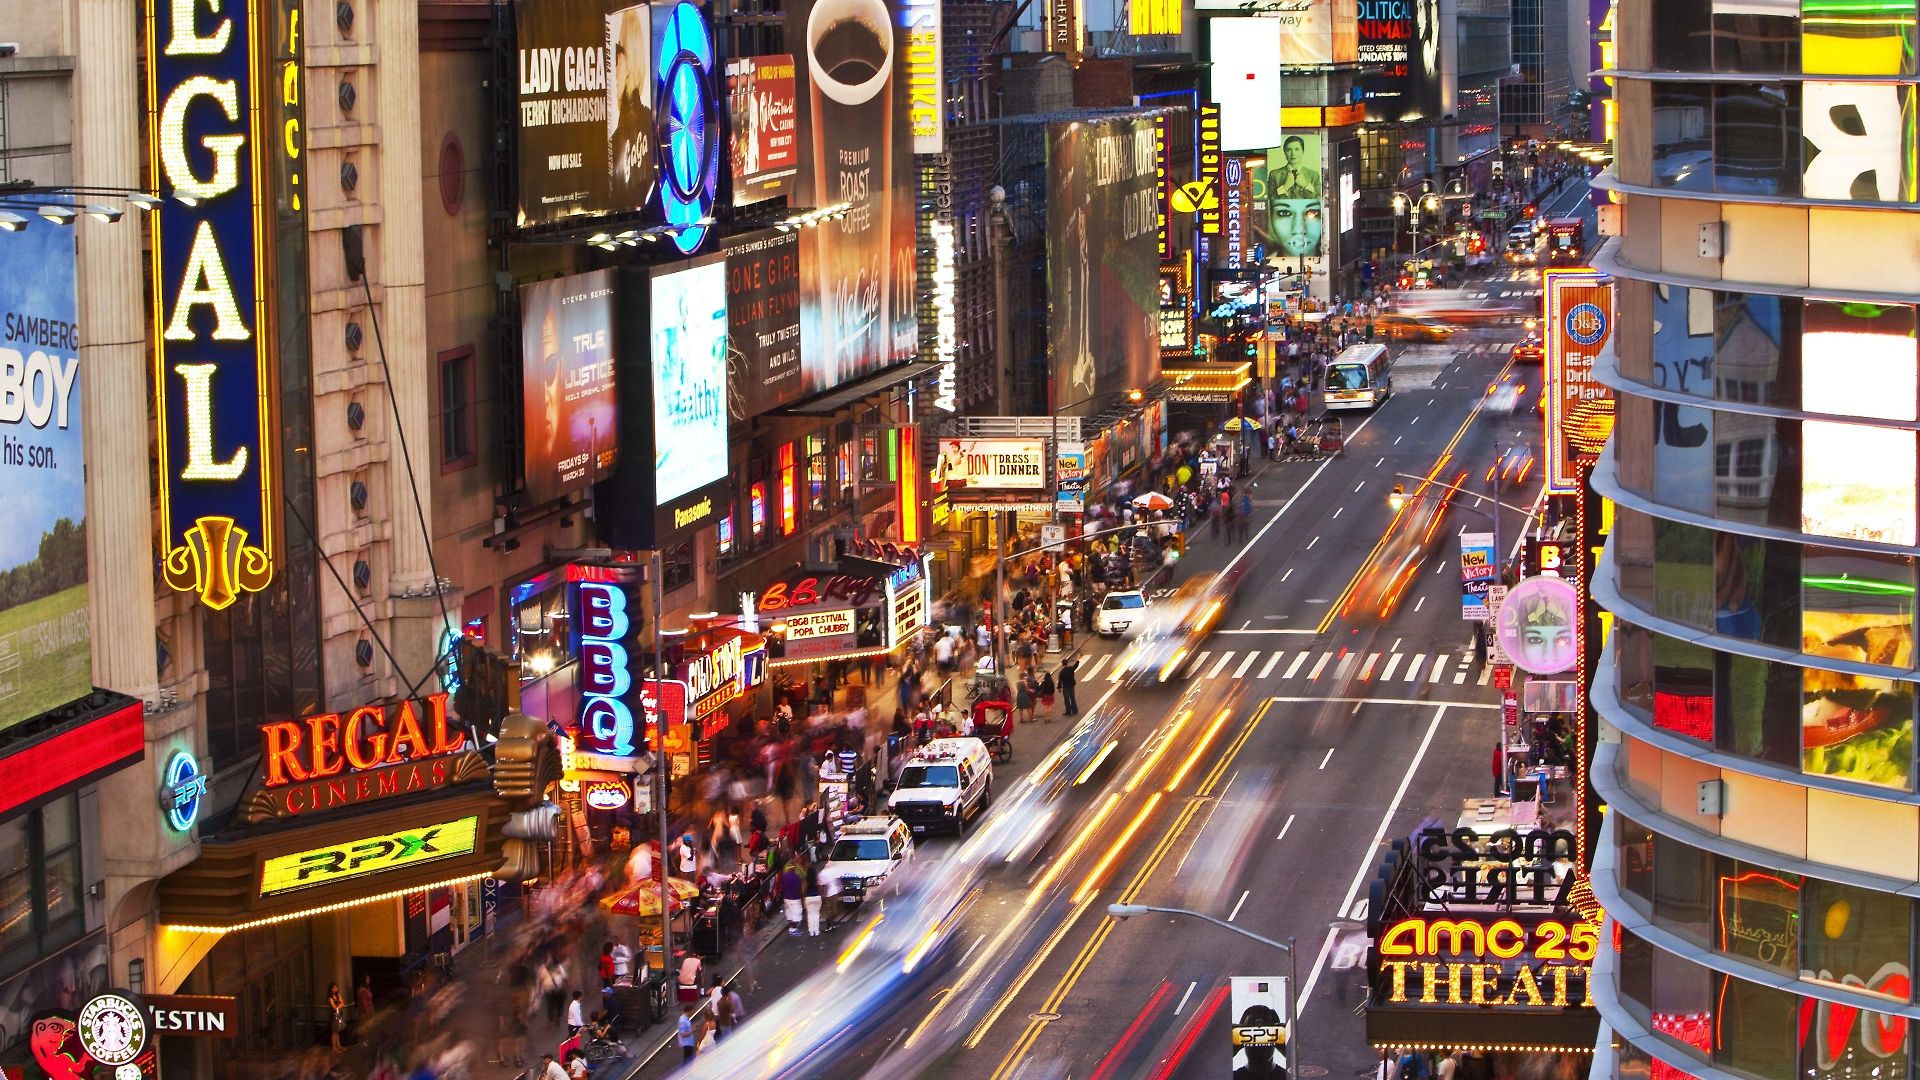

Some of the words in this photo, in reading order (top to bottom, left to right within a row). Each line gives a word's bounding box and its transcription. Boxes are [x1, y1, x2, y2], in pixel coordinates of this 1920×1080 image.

[520, 48, 561, 95] LADY
[564, 46, 606, 92] GAGA
[521, 100, 550, 127] TERRY
[551, 96, 606, 124] RICHARDSON
[569, 153, 582, 168] SALE
[840, 147, 870, 166] PREMIUM
[1096, 134, 1134, 186] LEONARD
[840, 168, 870, 204] ROAST
[840, 204, 871, 234] COFFEE
[1228, 189, 1241, 270] SKECHERS
[768, 254, 799, 286] GIRL
[562, 294, 587, 305] STEVEN
[5, 313, 79, 351] SAMBERG
[573, 330, 606, 354] TRUE
[777, 329, 799, 341] TWISTED
[769, 357, 781, 369] AND
[1566, 352, 1599, 366] Ea
[564, 359, 615, 390] JUSTICE
[1566, 369, 1595, 382] Dri
[0, 349, 79, 430] BOY
[3, 435, 24, 466] his
[28, 444, 57, 469] son.
[558, 455, 581, 472] FRIDAYS
[967, 454, 998, 476] DON'T
[1000, 454, 1029, 464] DRESS
[1059, 460, 1077, 468] New
[563, 470, 577, 482] MARCH
[1000, 465, 1040, 475] DINNER
[1059, 470, 1083, 479] Victory
[675, 496, 711, 529] Panasonic
[1463, 554, 1485, 566] New
[1463, 567, 1493, 580] Victory
[788, 618, 809, 626] CBGB
[811, 613, 848, 625] FESTIVAL
[794, 629, 814, 637] POPA
[819, 624, 849, 634] CHUBBY
[580, 583, 635, 756] BBQ
[688, 653, 712, 703] COLD
[262, 692, 464, 787] REGAL
[175, 773, 206, 808] RPX
[286, 760, 446, 815] CINEMAS
[295, 827, 441, 880] RPX
[1381, 919, 1524, 958] amc
[1535, 921, 1599, 961] 25
[81, 997, 142, 1031] STARBUCKS
[150, 1004, 225, 1032] ESTIN
[1240, 1029, 1278, 1042] SPY
[89, 1041, 136, 1062] COFFEE
